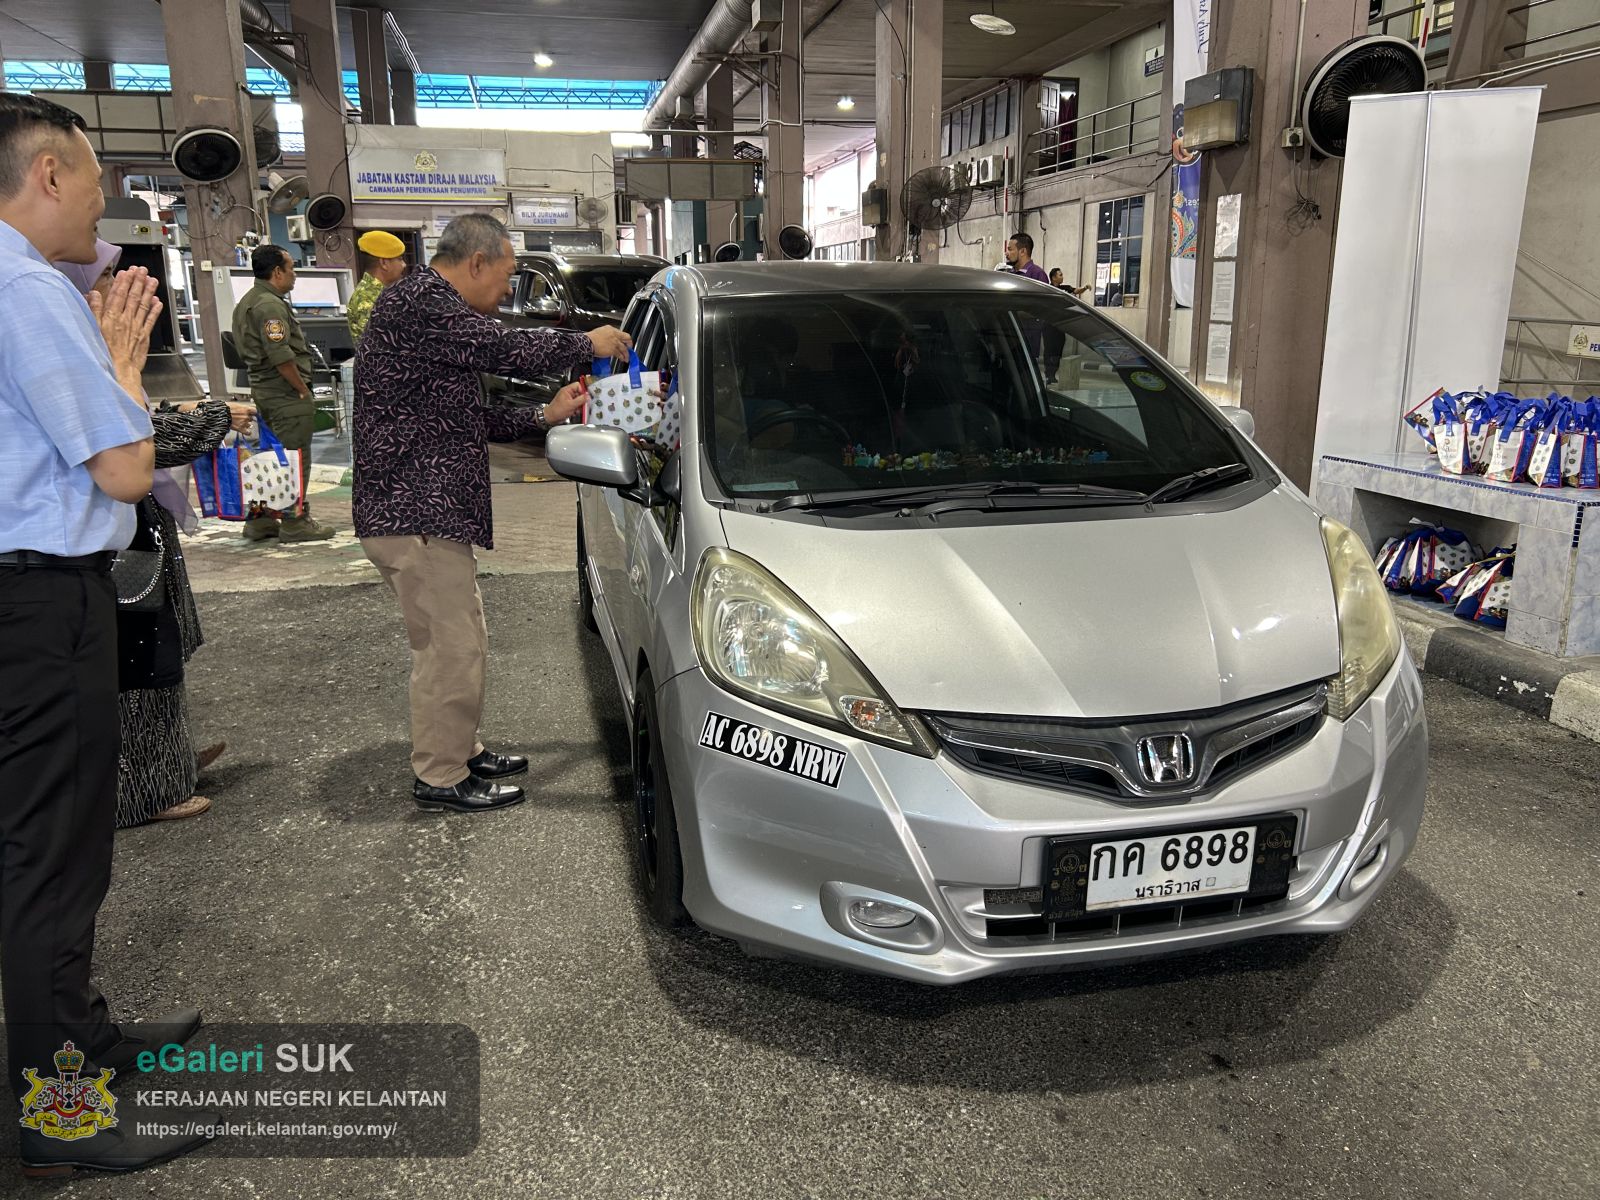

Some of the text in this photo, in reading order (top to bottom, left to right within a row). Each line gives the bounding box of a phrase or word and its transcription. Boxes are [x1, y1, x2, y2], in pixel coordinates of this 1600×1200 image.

[357, 172, 497, 185] JABATAN KASTAM DIRAJA MALAYSIA
[700, 714, 845, 785] AC 6898 NRW
[1091, 830, 1250, 881] กค 6898
[1134, 878, 1202, 899] นราธิวาส
